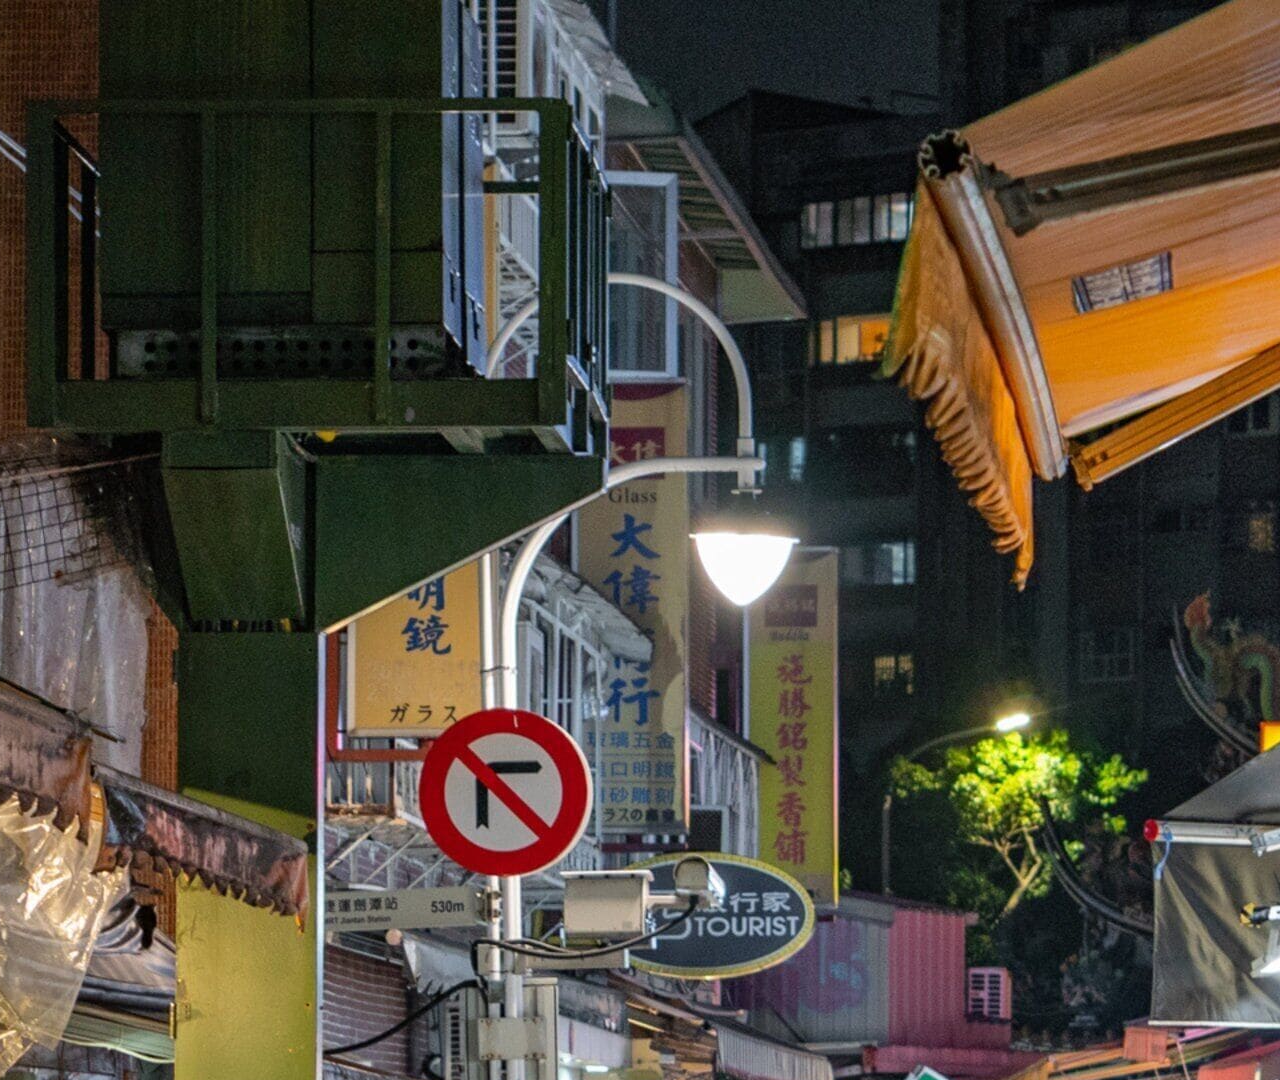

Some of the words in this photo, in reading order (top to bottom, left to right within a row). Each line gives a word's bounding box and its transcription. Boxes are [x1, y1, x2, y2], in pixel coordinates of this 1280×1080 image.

[609, 487, 658, 504] Glass
[390, 703, 458, 723] ガラス
[431, 901, 465, 913] 530m
[694, 916, 799, 937] TOURIST
